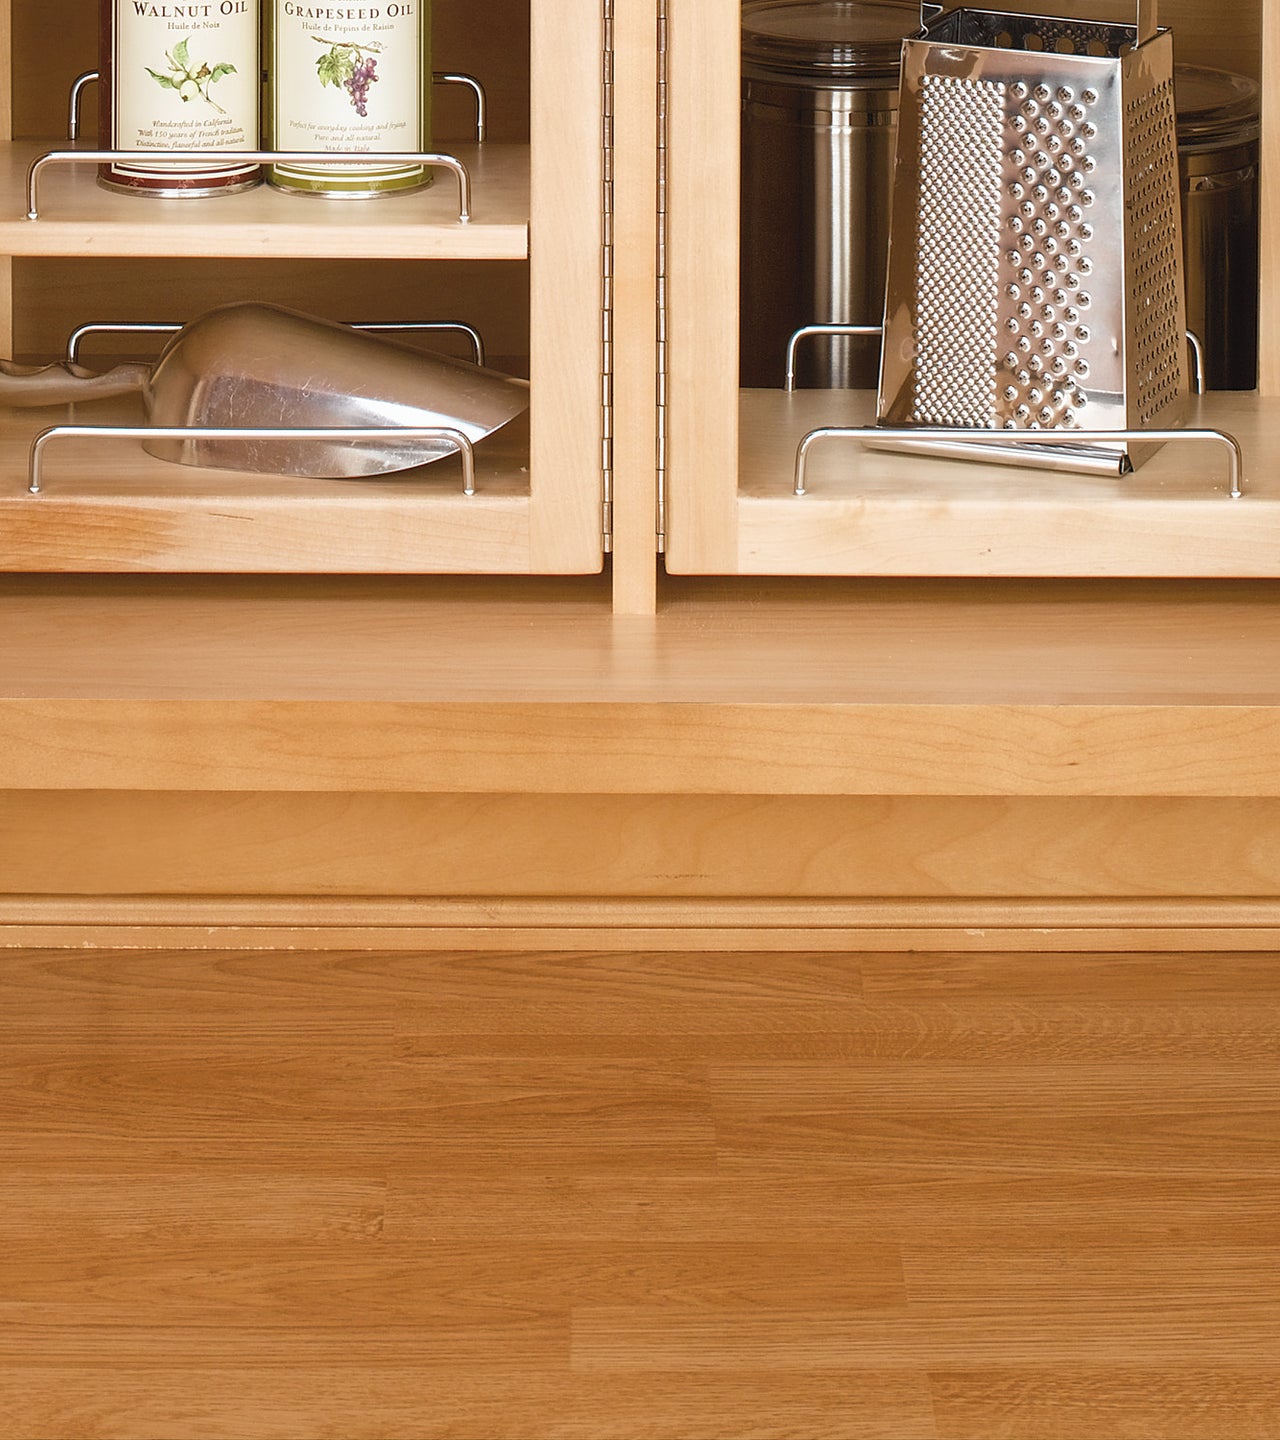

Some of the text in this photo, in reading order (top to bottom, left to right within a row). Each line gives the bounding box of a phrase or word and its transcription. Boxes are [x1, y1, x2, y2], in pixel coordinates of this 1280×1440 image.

[167, 21, 220, 30] Huile de Noix
[302, 21, 321, 31] Huile
[323, 22, 332, 32] de
[361, 22, 371, 31] de
[373, 22, 395, 31] Raisin
[152, 119, 194, 128] Handcrafted
[203, 118, 233, 127] California
[308, 122, 317, 130] for
[318, 123, 348, 132] everyday
[349, 124, 375, 132] cooking
[376, 122, 388, 130] and
[137, 129, 153, 137] With
[155, 130, 168, 138] 150
[168, 132, 188, 140] years
[189, 131, 196, 139] of
[198, 129, 220, 138] French
[171, 140, 202, 149] flavorful
[202, 140, 215, 148] and
